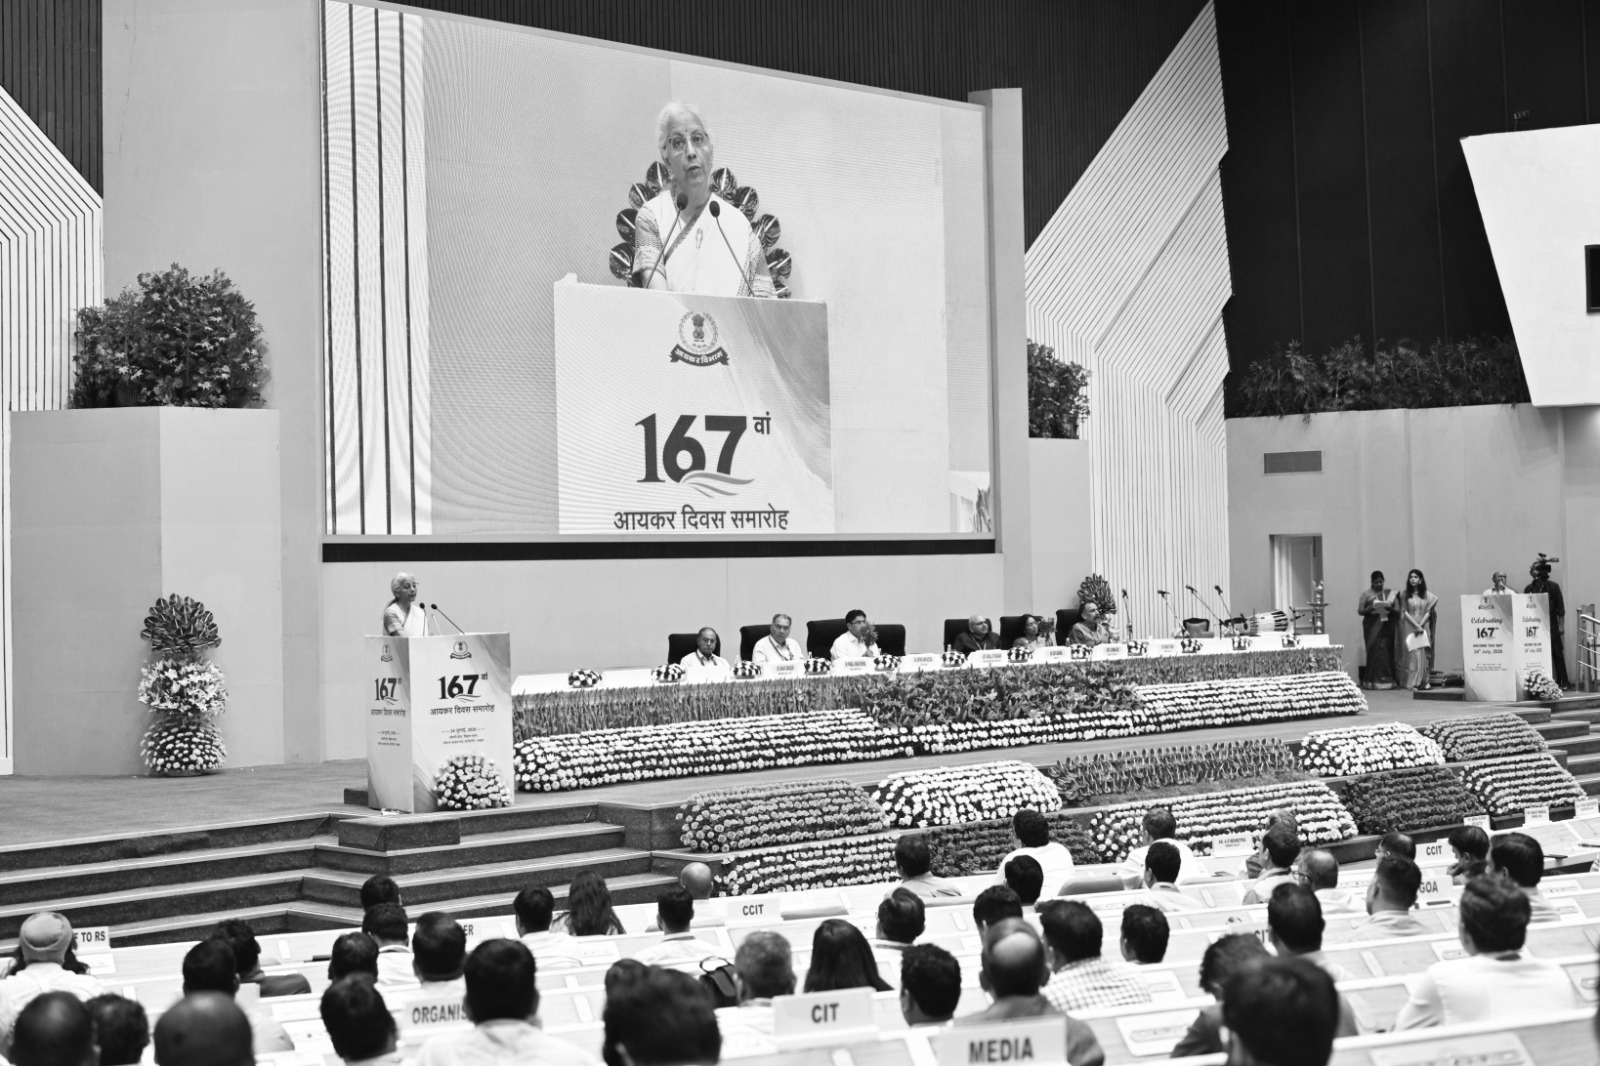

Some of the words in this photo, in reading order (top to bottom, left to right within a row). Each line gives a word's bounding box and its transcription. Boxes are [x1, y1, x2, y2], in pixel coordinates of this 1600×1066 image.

[613, 510, 677, 531] आयकर
[680, 504, 727, 530] दिवस
[730, 502, 790, 531] समारोह
[1470, 616, 1503, 625] Celebrating
[374, 677, 397, 701] 167
[437, 673, 480, 700] 167
[430, 707, 453, 716] आयकर
[454, 704, 472, 715] दिवस
[472, 702, 496, 713] समारोह
[1426, 845, 1442, 856] CCIT
[742, 904, 764, 916] CCIT
[81, 931, 93, 943] TO
[94, 930, 106, 942] RS
[811, 1003, 840, 1023] CIT
[969, 1036, 1034, 1063] MEDIA
